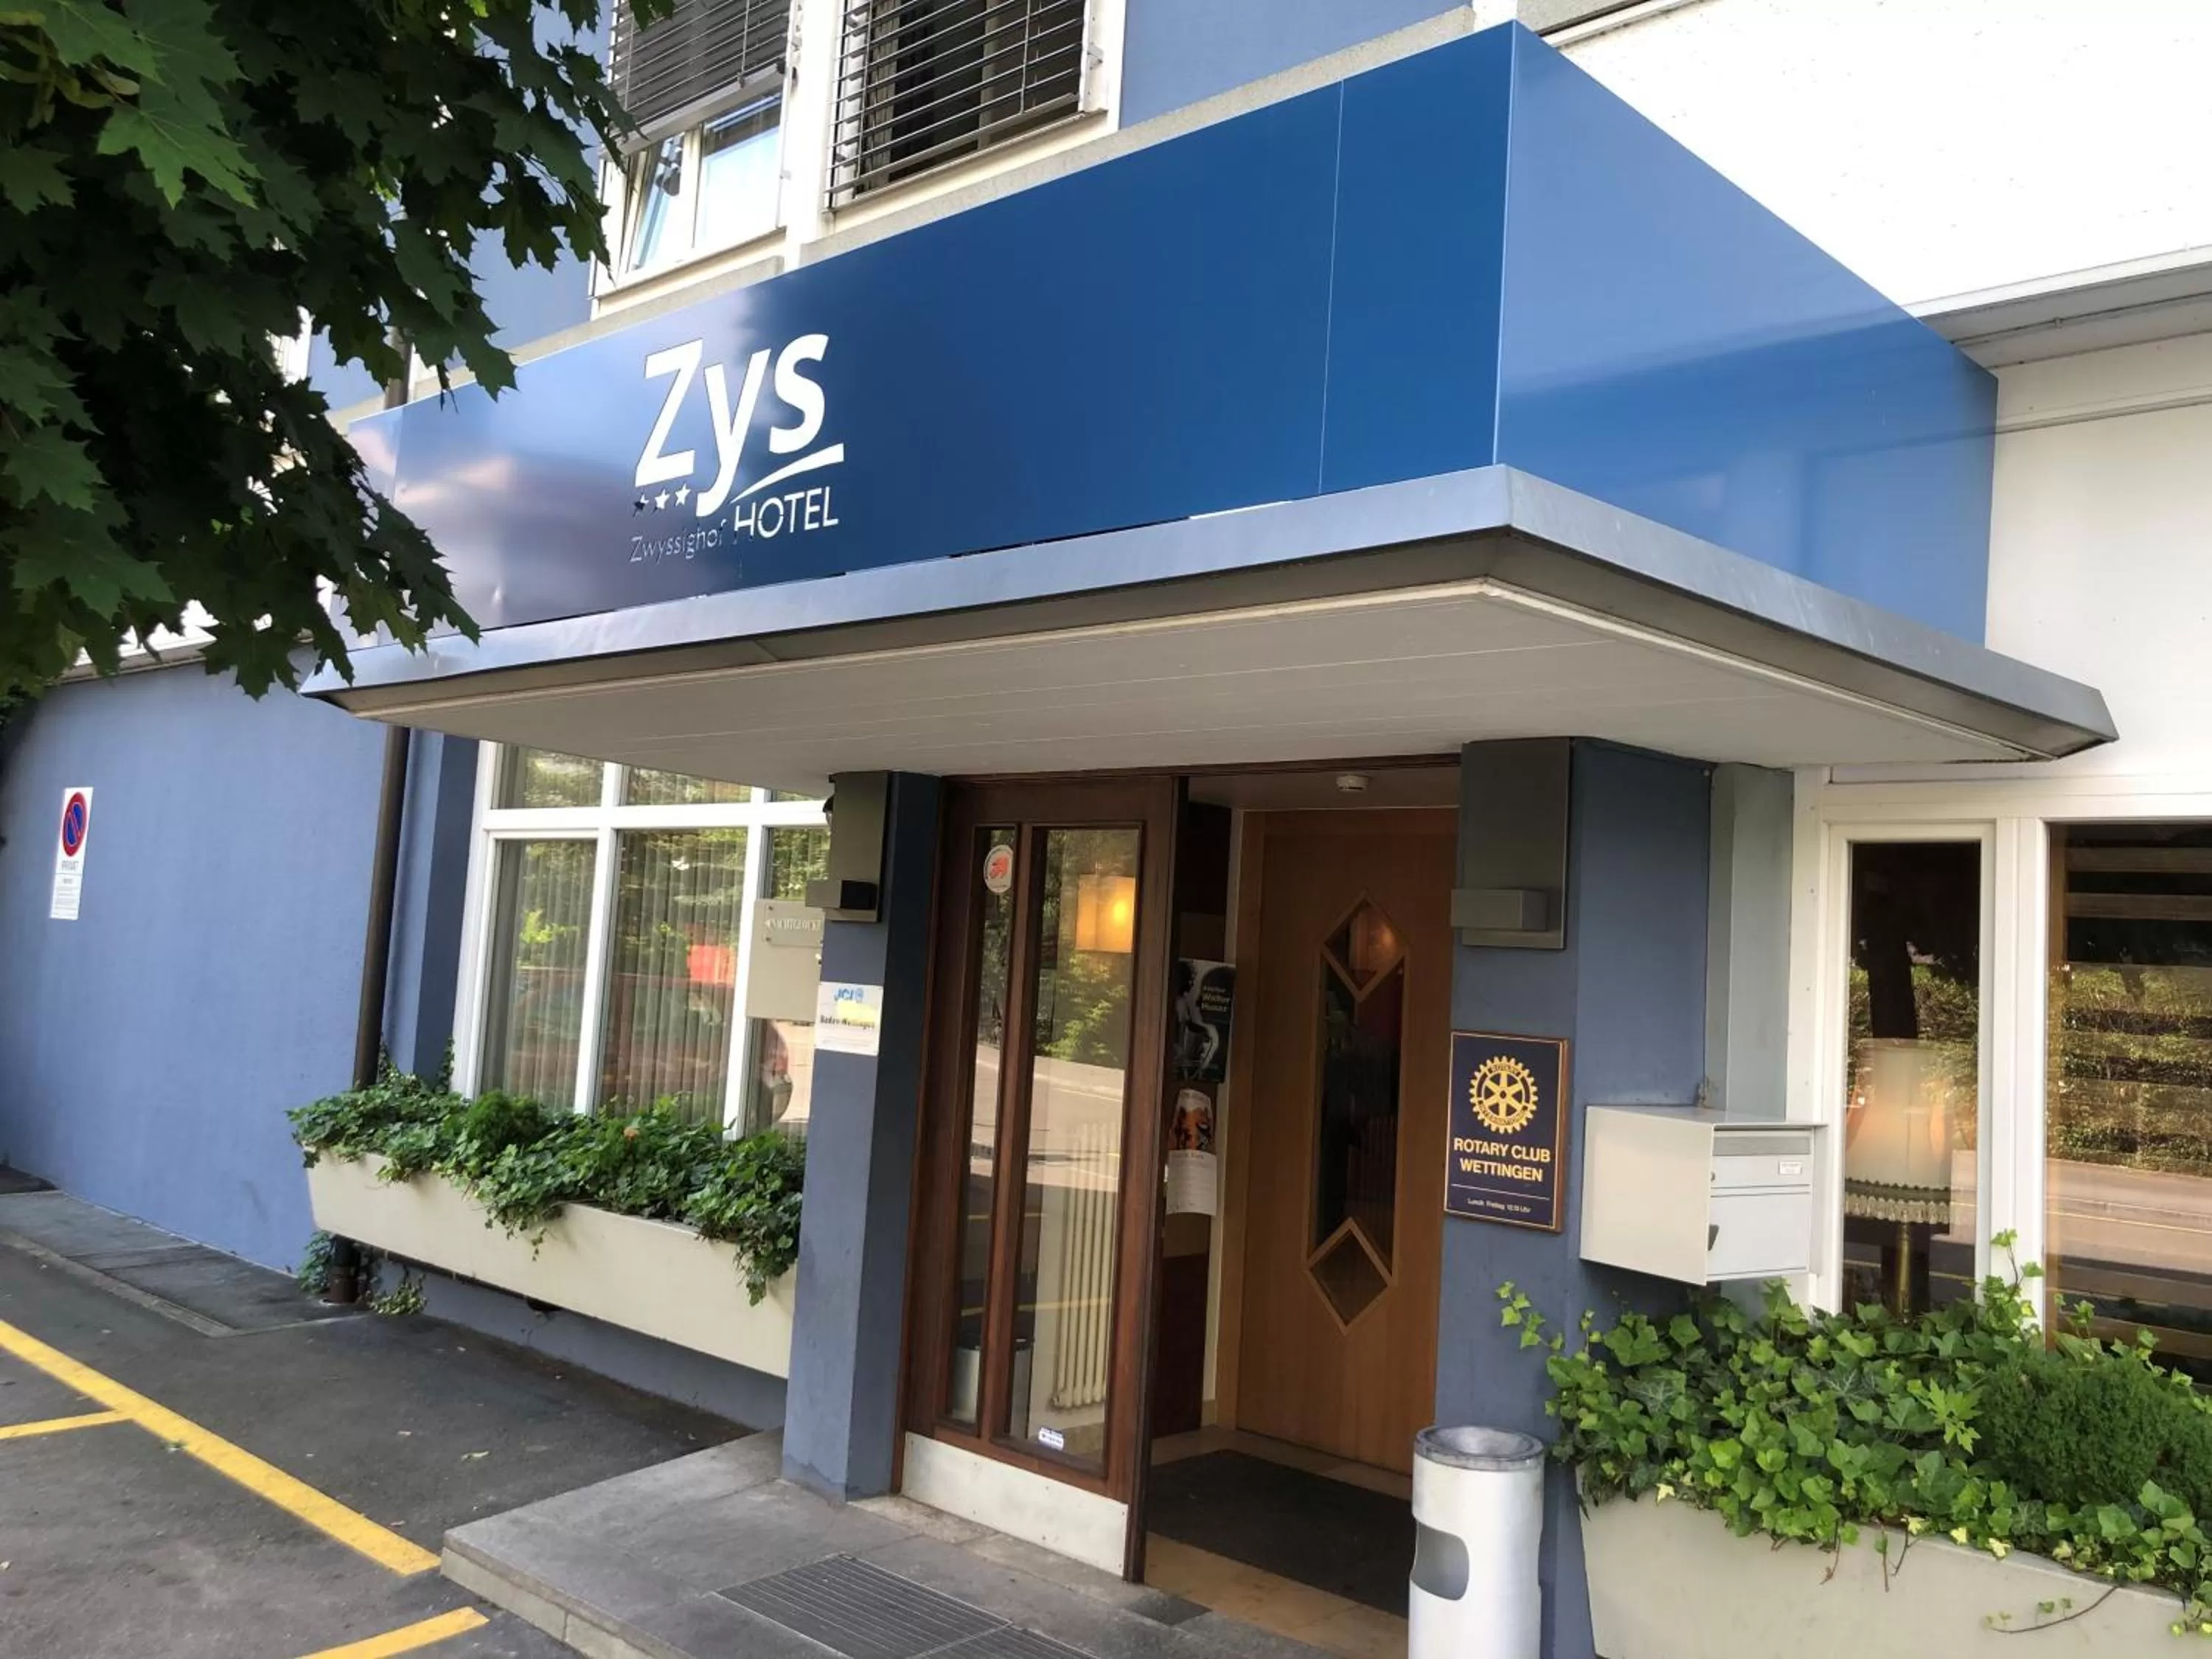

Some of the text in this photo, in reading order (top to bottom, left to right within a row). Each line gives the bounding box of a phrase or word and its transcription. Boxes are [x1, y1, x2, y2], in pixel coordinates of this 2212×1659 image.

[636, 333, 829, 517] Zys
[734, 486, 839, 542] HOTEL
[1453, 1138, 1551, 1162] ROTARY CLUB
[1460, 1158, 1543, 1182] WETTINGEN
